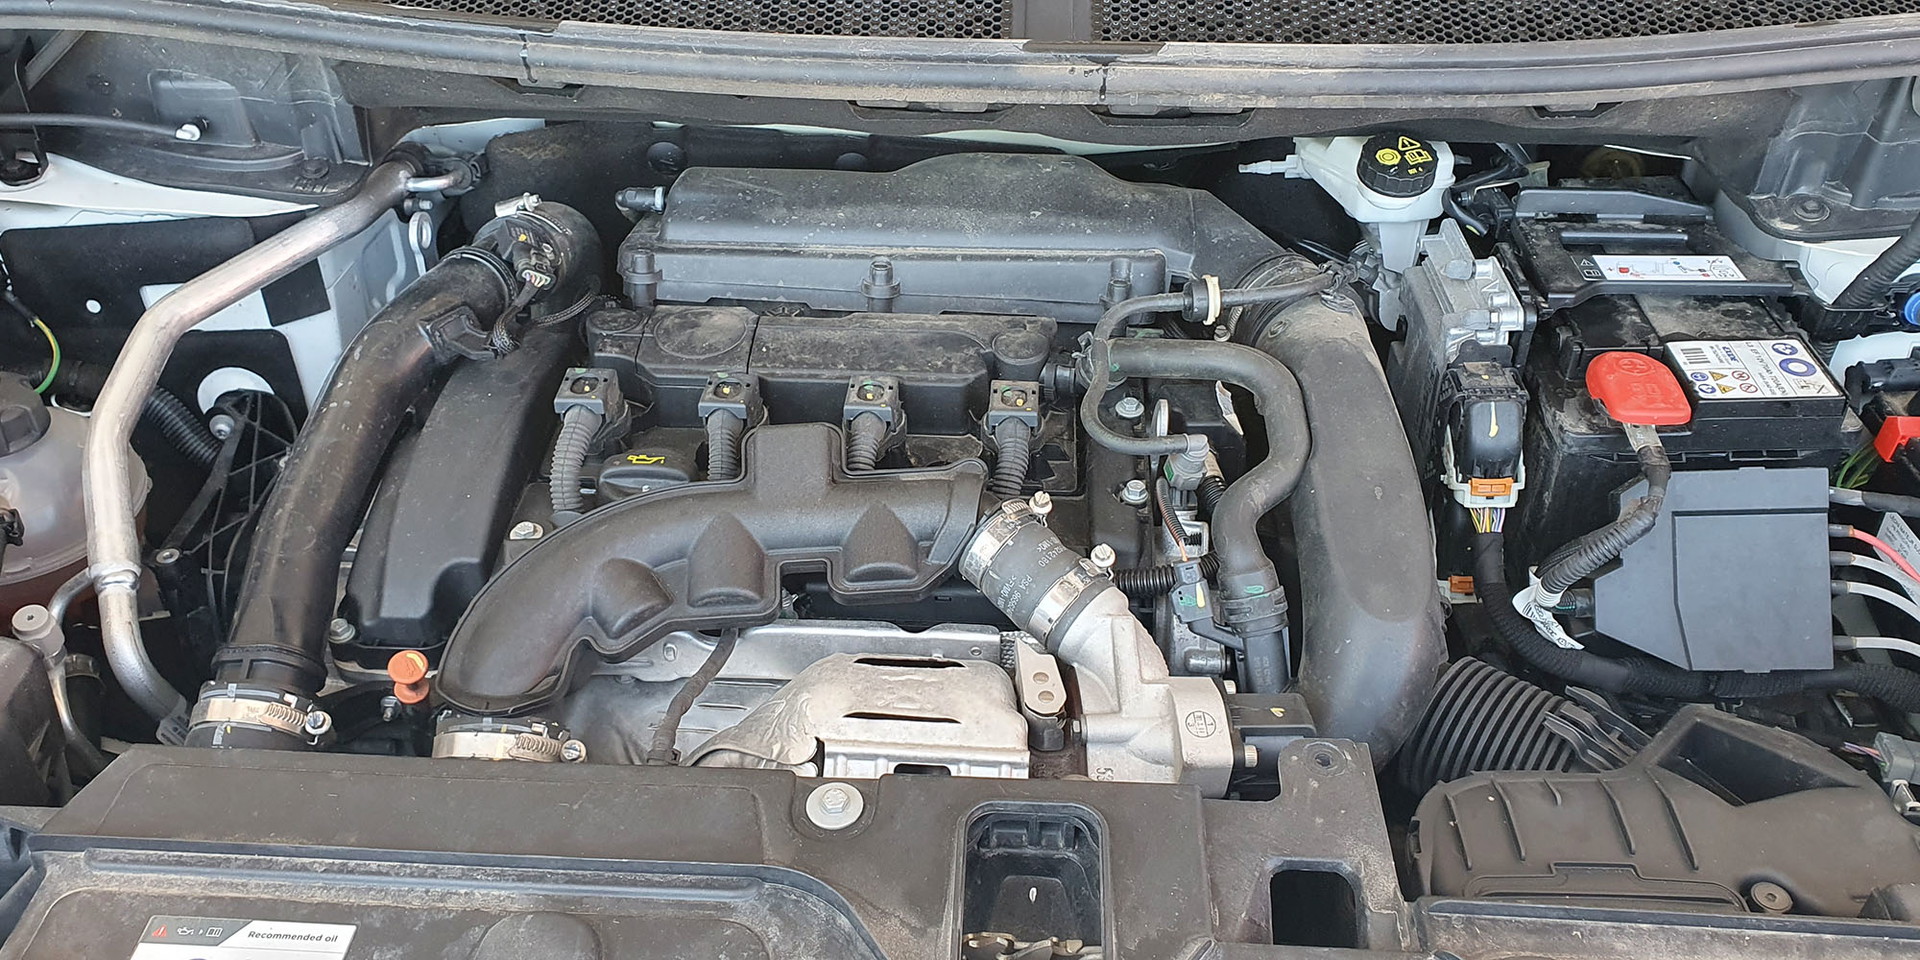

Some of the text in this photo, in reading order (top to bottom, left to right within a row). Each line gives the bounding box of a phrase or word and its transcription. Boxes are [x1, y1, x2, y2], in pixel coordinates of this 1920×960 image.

[1018, 574, 1033, 591] PSA
[248, 931, 338, 943] Recommended oil
